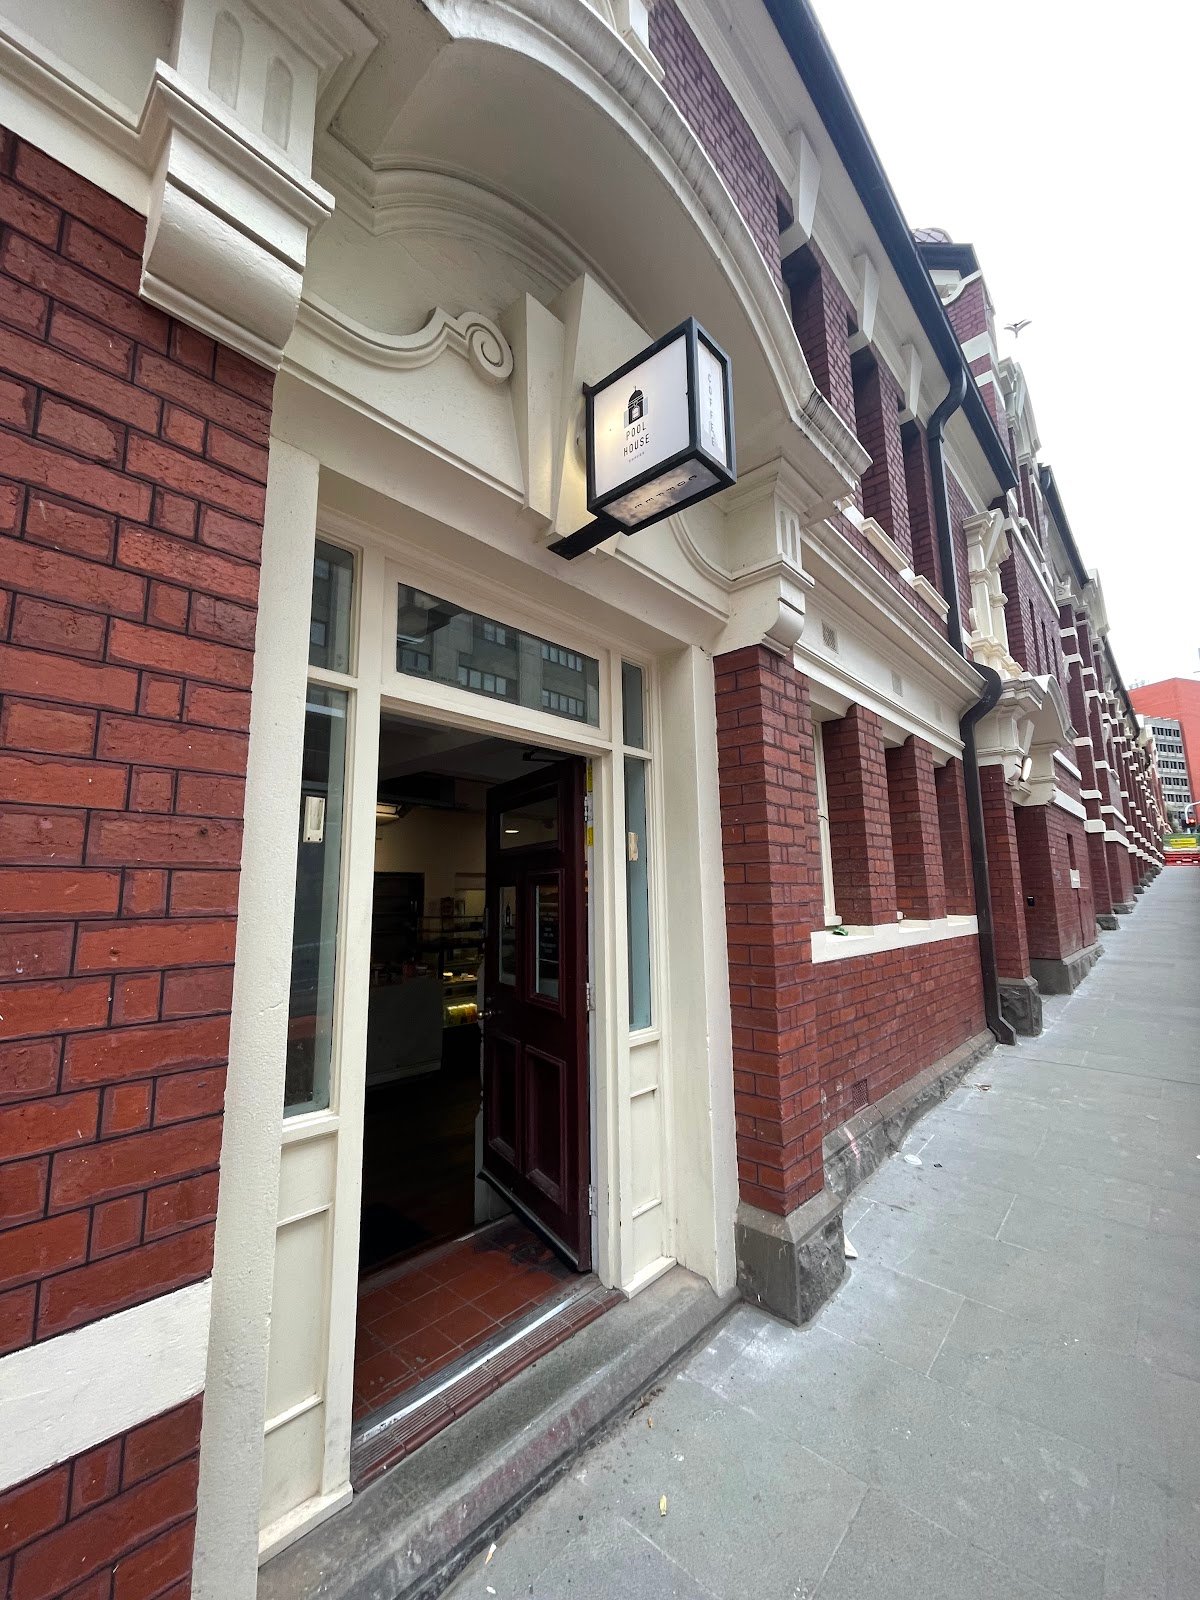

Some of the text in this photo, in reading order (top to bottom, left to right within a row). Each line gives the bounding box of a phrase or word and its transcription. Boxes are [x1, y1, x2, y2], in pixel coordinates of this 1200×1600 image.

[708, 373, 716, 447] COFFEE
[623, 433, 650, 457] HOUSE
[626, 422, 647, 441] POOL
[634, 474, 698, 509] COFFEE
